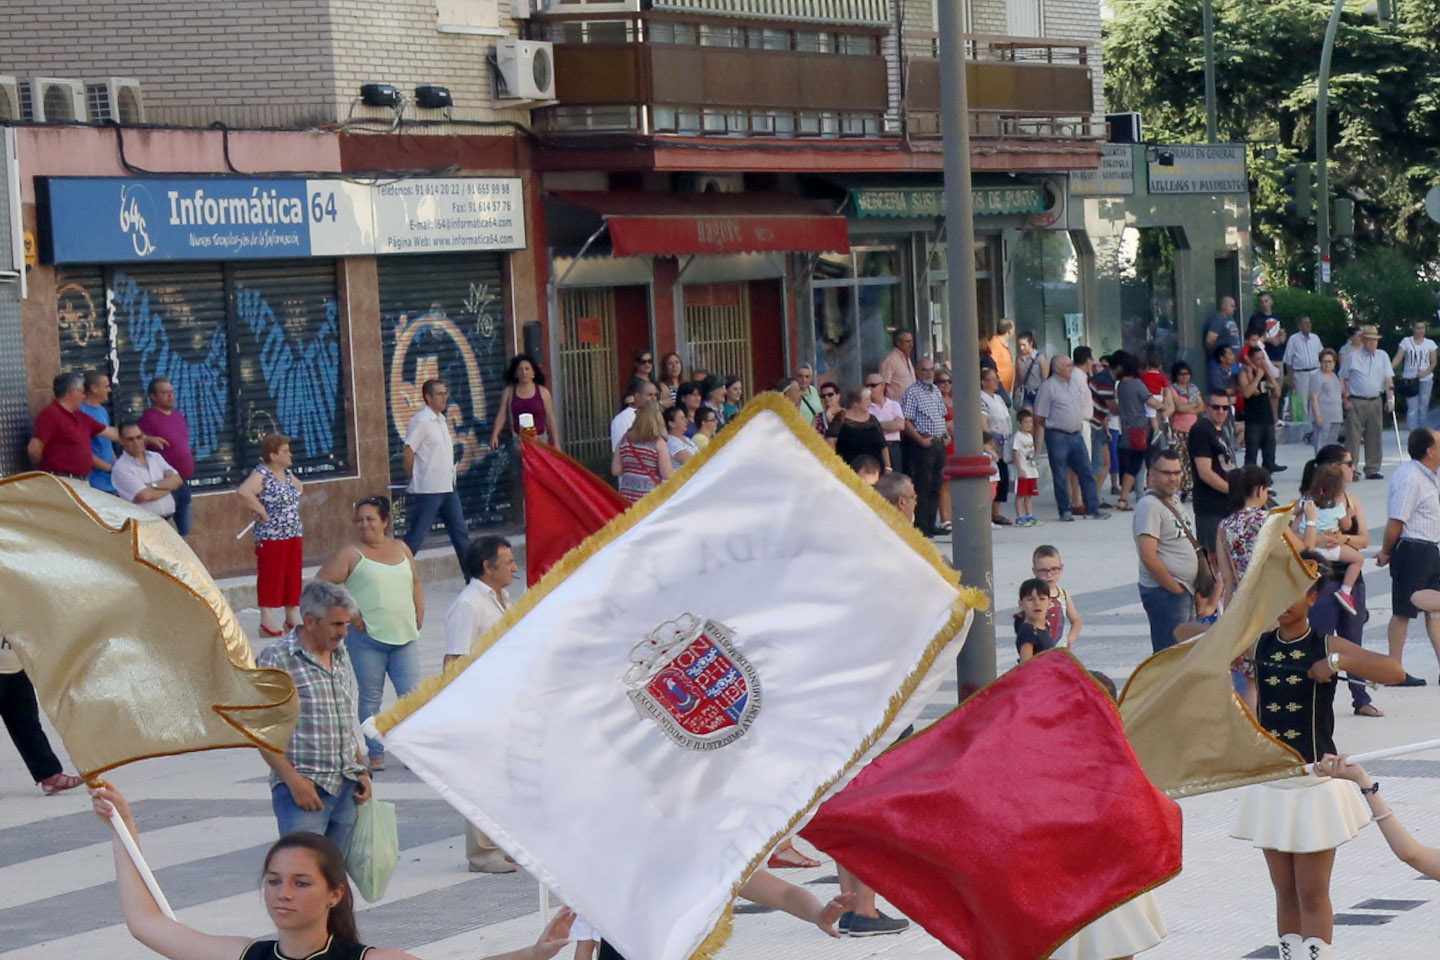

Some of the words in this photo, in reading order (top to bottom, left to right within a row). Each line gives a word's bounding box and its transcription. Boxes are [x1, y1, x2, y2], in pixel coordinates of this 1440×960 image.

[415, 184, 424, 195] 91
[426, 184, 439, 195] 614
[441, 184, 450, 195] 20
[451, 184, 460, 195] 22
[467, 184, 475, 195] 91
[491, 184, 500, 194] 99
[167, 187, 303, 225] Informática
[312, 192, 338, 223] 64
[989, 192, 1002, 209] DE
[452, 202, 467, 213] Fax:
[469, 202, 477, 212] 91
[388, 236, 412, 249] Página
[414, 236, 431, 247] Web:
